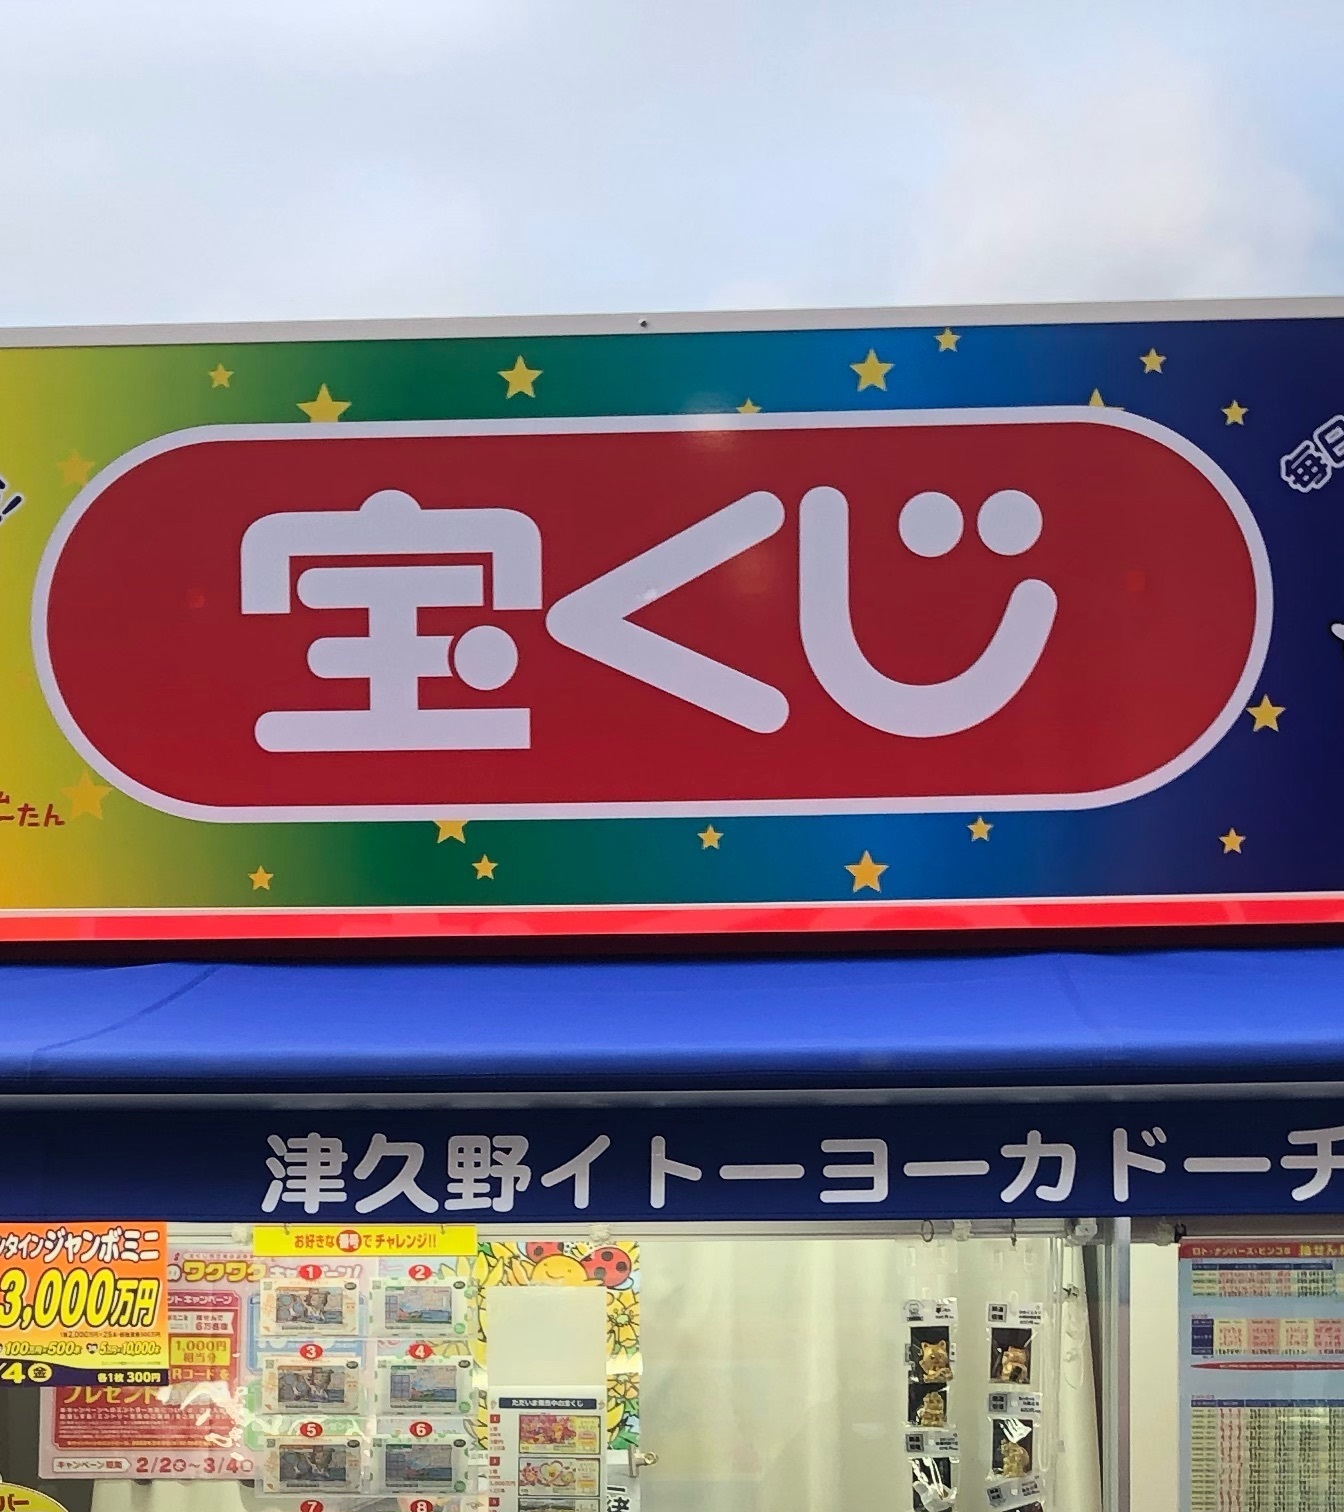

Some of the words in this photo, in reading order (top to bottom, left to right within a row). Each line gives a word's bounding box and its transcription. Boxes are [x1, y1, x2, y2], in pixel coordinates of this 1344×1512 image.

[240, 485, 1058, 752] 宝くじ
[175, 1340, 227, 1352] 1,000円
